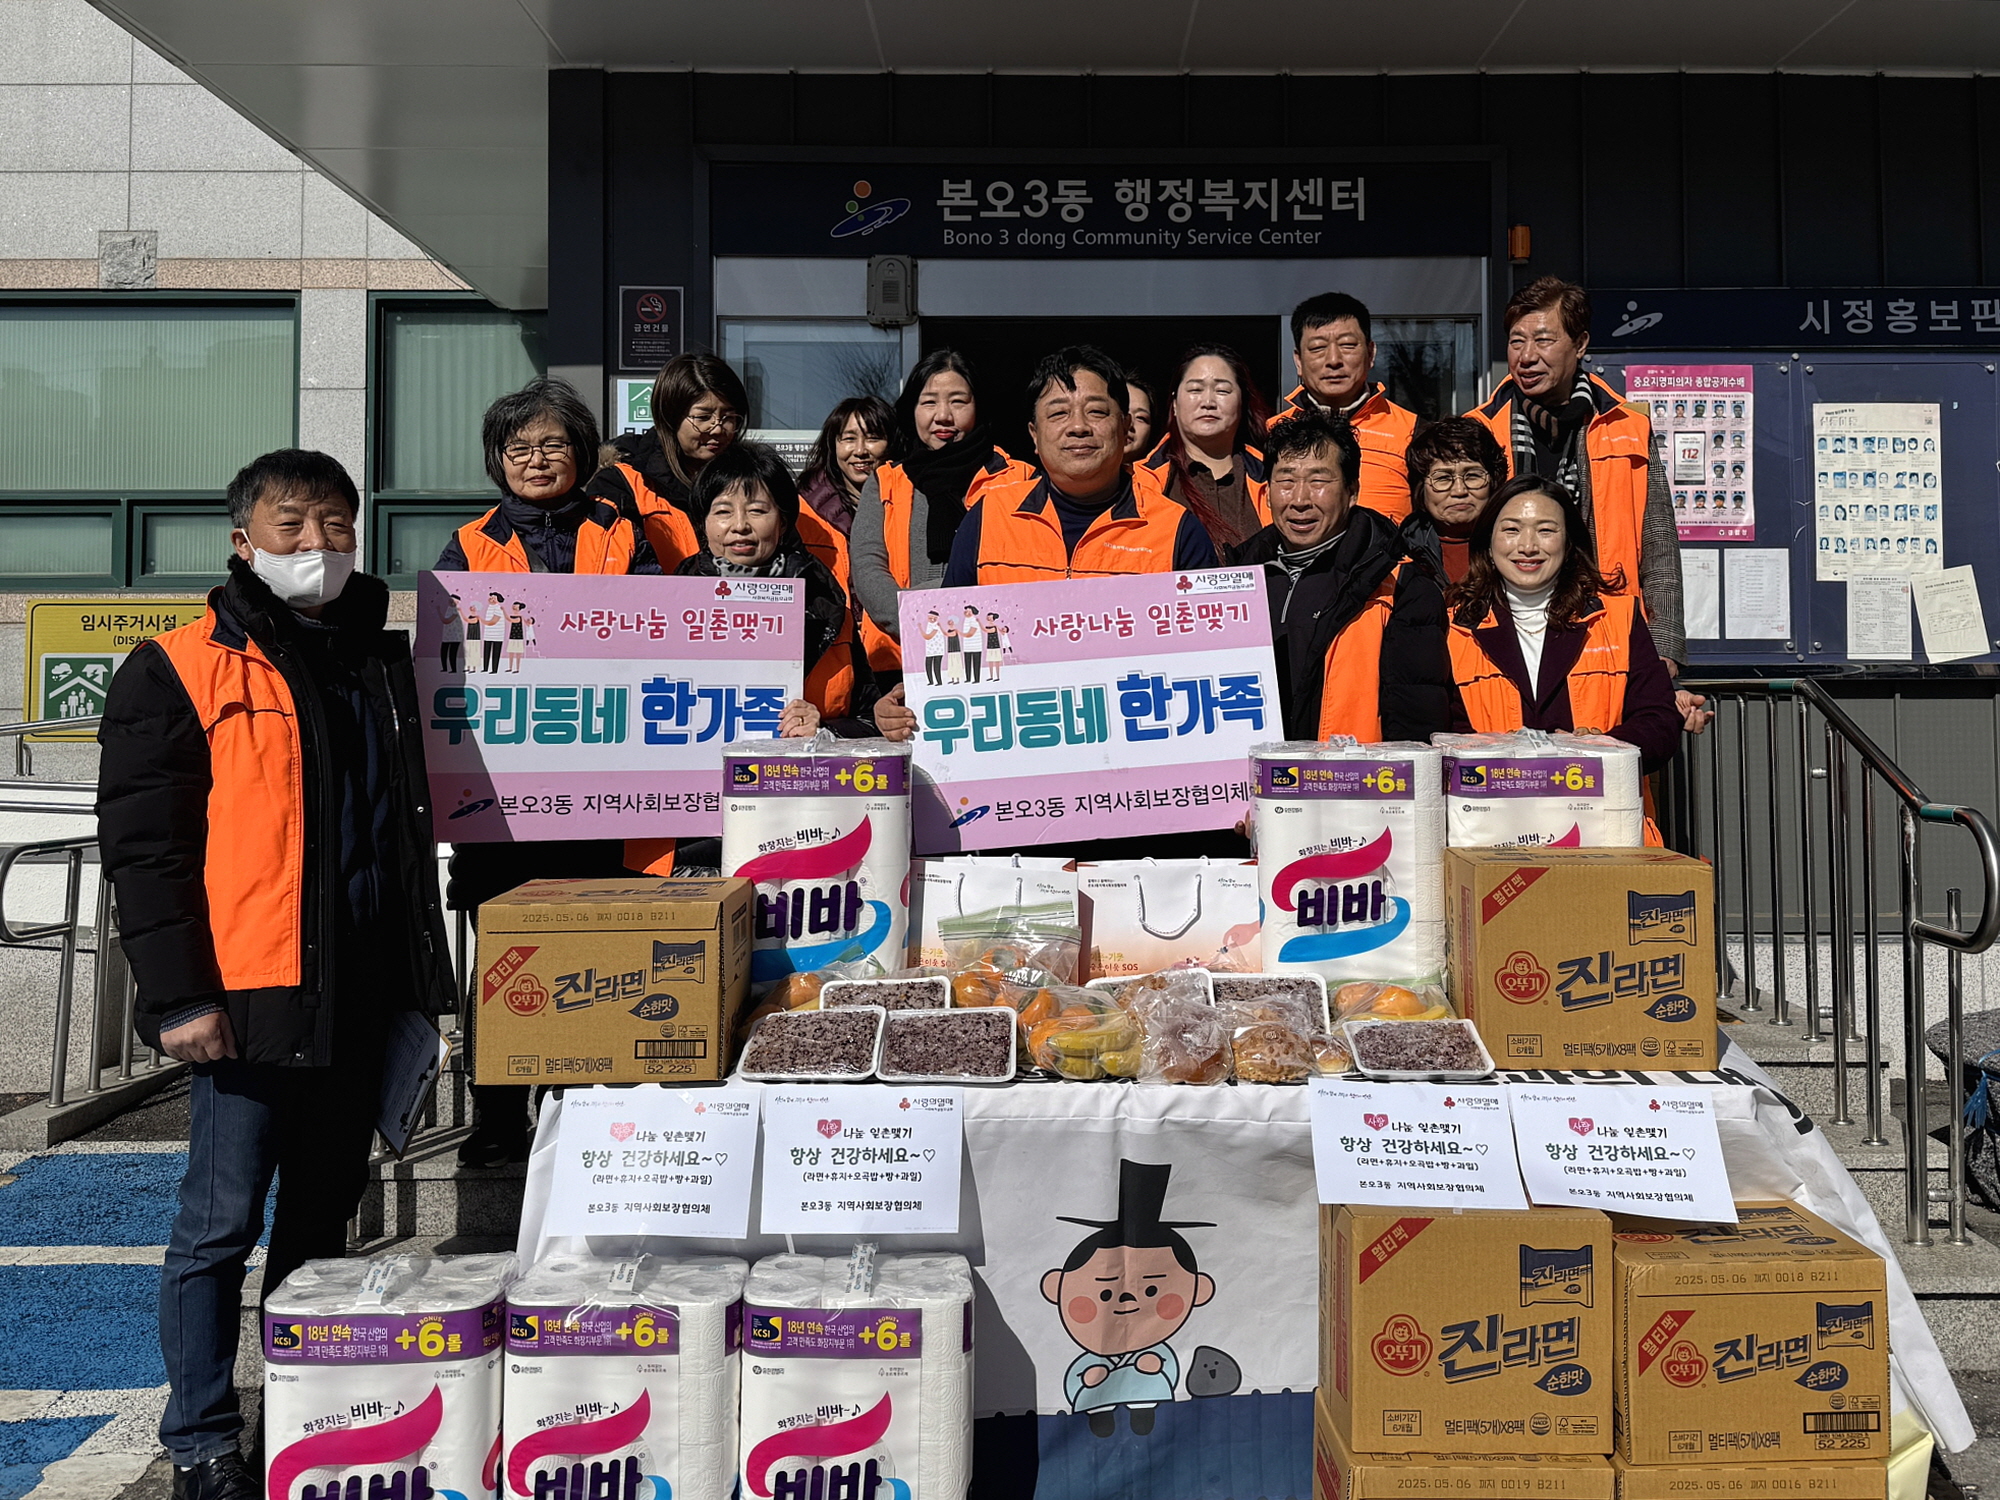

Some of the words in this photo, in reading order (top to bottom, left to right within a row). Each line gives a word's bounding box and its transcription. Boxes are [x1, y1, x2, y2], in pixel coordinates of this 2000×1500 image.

[936, 178, 1093, 222] 본오3동
[1114, 176, 1368, 223] 행정복지센터
[943, 228, 992, 246] Bono
[998, 229, 1010, 246] 3
[1017, 227, 1065, 249] dong
[1072, 227, 1182, 249] Community
[1187, 228, 1254, 246] Service
[1259, 228, 1322, 246] Center
[1799, 298, 2000, 335] 시정홍보판
[633, 323, 669, 333] 금연건물
[1633, 376, 1693, 388] 중요지명피의자
[1695, 376, 1745, 388] 종합공개수배
[1681, 448, 1699, 460] 112
[1195, 571, 1254, 586] 사랑의열매
[735, 582, 793, 595] 사랑의열매
[81, 613, 177, 632] 임시주거시설
[560, 608, 668, 640] 사랑나눔
[682, 608, 784, 641] 일촌맺기
[1032, 607, 1136, 642] 사랑나눔
[1147, 600, 1249, 636] 일촌맺기
[430, 687, 627, 745] 우리동네
[642, 677, 785, 745] 한가족
[923, 687, 1109, 755] 우리동네
[1116, 670, 1265, 744] 한가족
[763, 765, 781, 777] 18년
[782, 764, 799, 777] 연속
[1303, 770, 1318, 780] 18년
[1491, 768, 1505, 779] 18년
[499, 794, 574, 816] 본오3동
[584, 791, 720, 815] 지역사회보장협
[995, 796, 1066, 822] 본오3동
[1074, 780, 1249, 815] 지역사회보장협의체
[758, 838, 793, 852] 화장지는
[1298, 843, 1328, 857] 화장지는
[1492, 873, 1527, 907] 멀티팩
[755, 880, 864, 939] 비바
[1297, 880, 1387, 927] 비바
[617, 912, 643, 922] 0018
[1640, 908, 1684, 929] 진라면
[485, 949, 524, 988] 멀티팩
[660, 955, 696, 970] 진라면
[1122, 963, 1139, 971] SOS
[1505, 978, 1540, 991] 오뚜기
[1555, 950, 1685, 1012] 진라면
[552, 968, 647, 1013] 진라면
[512, 995, 542, 1007] 오뚜기
[638, 998, 674, 1018] 순한맛
[1654, 998, 1690, 1020] 순한맛
[1510, 1037, 1538, 1046] 소비기간
[1516, 1046, 1535, 1055] 6개월
[647, 1064, 664, 1074] 52
[668, 1064, 692, 1074] 225
[708, 1101, 750, 1112] 사랑의열매
[912, 1097, 954, 1108] 사랑의열매
[1457, 1096, 1499, 1107] 사랑의열매
[1662, 1100, 1704, 1110] 사랑의열매
[820, 1123, 838, 1135] 사랑
[844, 1127, 865, 1139] 나눔
[869, 1127, 912, 1139] 일촌맺기
[1367, 1116, 1385, 1126] 사랑
[1391, 1121, 1414, 1133] 나눔
[1417, 1122, 1462, 1135] 일촌맺기
[1572, 1121, 1591, 1131] 사랑
[1597, 1126, 1619, 1138] 나눔
[1623, 1126, 1668, 1139] 일촌맺기
[636, 1131, 658, 1142] 나눔
[663, 1130, 706, 1143] 일촌맺기
[1340, 1136, 1372, 1153] 항상
[1382, 1138, 1474, 1156] 건강하세요~
[1545, 1142, 1577, 1161] 항상
[1588, 1143, 1680, 1162] 건강하세요~
[581, 1149, 613, 1168] 항상
[621, 1150, 713, 1168] 건강하세요~
[790, 1148, 822, 1166] 항상
[830, 1147, 922, 1165] 건강하세요~
[1356, 1157, 1479, 1172] (라면+휴지+오곡밥+빵+과일)
[1563, 1164, 1687, 1179] (라면+휴지+오곡밥+빵+과일)
[592, 1171, 713, 1186] (라면+휴지+오곡밥+빵+과일)
[803, 1170, 922, 1184] (라면+휴지+오곡밥+빵+과일)
[1358, 1180, 1392, 1192] 본오3동
[1397, 1181, 1486, 1194] 지역사회보장협의체
[1568, 1187, 1601, 1199] 본오3동
[1606, 1189, 1694, 1203] 지역사회보장협의체
[588, 1201, 619, 1214] 본오3동
[623, 1201, 711, 1215] 지역사회보장협의체
[800, 1200, 833, 1213] 본오3동
[837, 1199, 922, 1213] 지역사회보장협의체
[1370, 1223, 1410, 1262] 멀티팩
[1531, 1265, 1581, 1289] 진라면
[1775, 1272, 1804, 1283] 0018
[307, 1325, 328, 1341] 18년
[331, 1324, 352, 1342] 연속
[511, 1327, 528, 1337] KCSI
[543, 1320, 561, 1333] 18년
[753, 1328, 770, 1338] KCSI
[787, 1321, 805, 1333] 18년
[806, 1321, 824, 1335] 연속
[1826, 1318, 1864, 1334] 진라면
[274, 1337, 291, 1346] KCSI
[1641, 1314, 1679, 1357] 멀티팩
[1383, 1343, 1423, 1361] 오뚜기
[1438, 1313, 1580, 1384] 진라면
[1712, 1333, 1811, 1384] 진라면
[1669, 1363, 1700, 1377] 오뚜기
[1805, 1366, 1842, 1389] 순한맛
[1546, 1371, 1585, 1392] 순한맛
[303, 1414, 346, 1433] 화장지는
[536, 1411, 573, 1428] 화장지는
[777, 1413, 814, 1429] 화장지는
[1387, 1413, 1417, 1423] 소비기간
[1393, 1423, 1413, 1433] 6개월
[1671, 1433, 1699, 1441] 소비기간
[1818, 1439, 1835, 1449] 52
[1840, 1439, 1866, 1449] 225
[1677, 1442, 1695, 1451] 6개월
[534, 1455, 643, 1500] 비바
[773, 1458, 882, 1500] 비바
[1501, 1479, 1530, 1490] 0019
[1772, 1479, 1801, 1490] 0016
